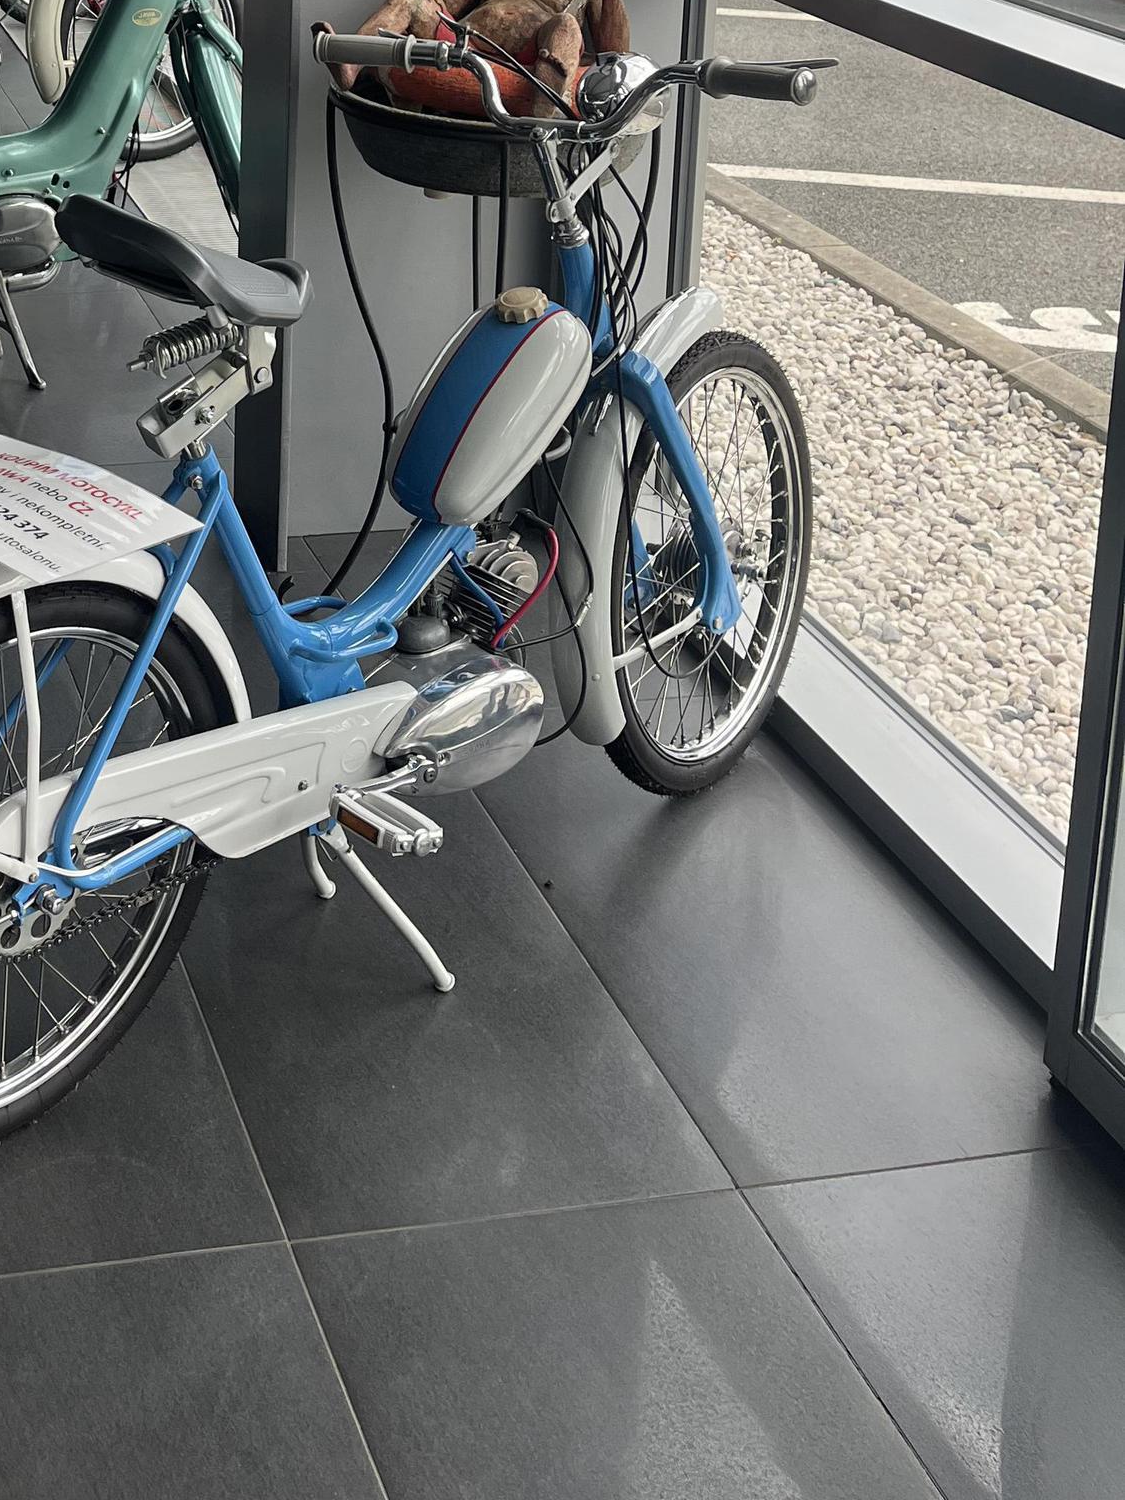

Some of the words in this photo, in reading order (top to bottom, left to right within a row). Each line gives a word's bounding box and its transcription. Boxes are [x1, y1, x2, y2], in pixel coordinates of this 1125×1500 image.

[28, 480, 68, 502] nebo
[68, 500, 94, 517] ČZ.
[55, 472, 143, 520] MOTOCYKL
[14, 520, 50, 540] 374
[16, 495, 110, 551] nekompletní.
